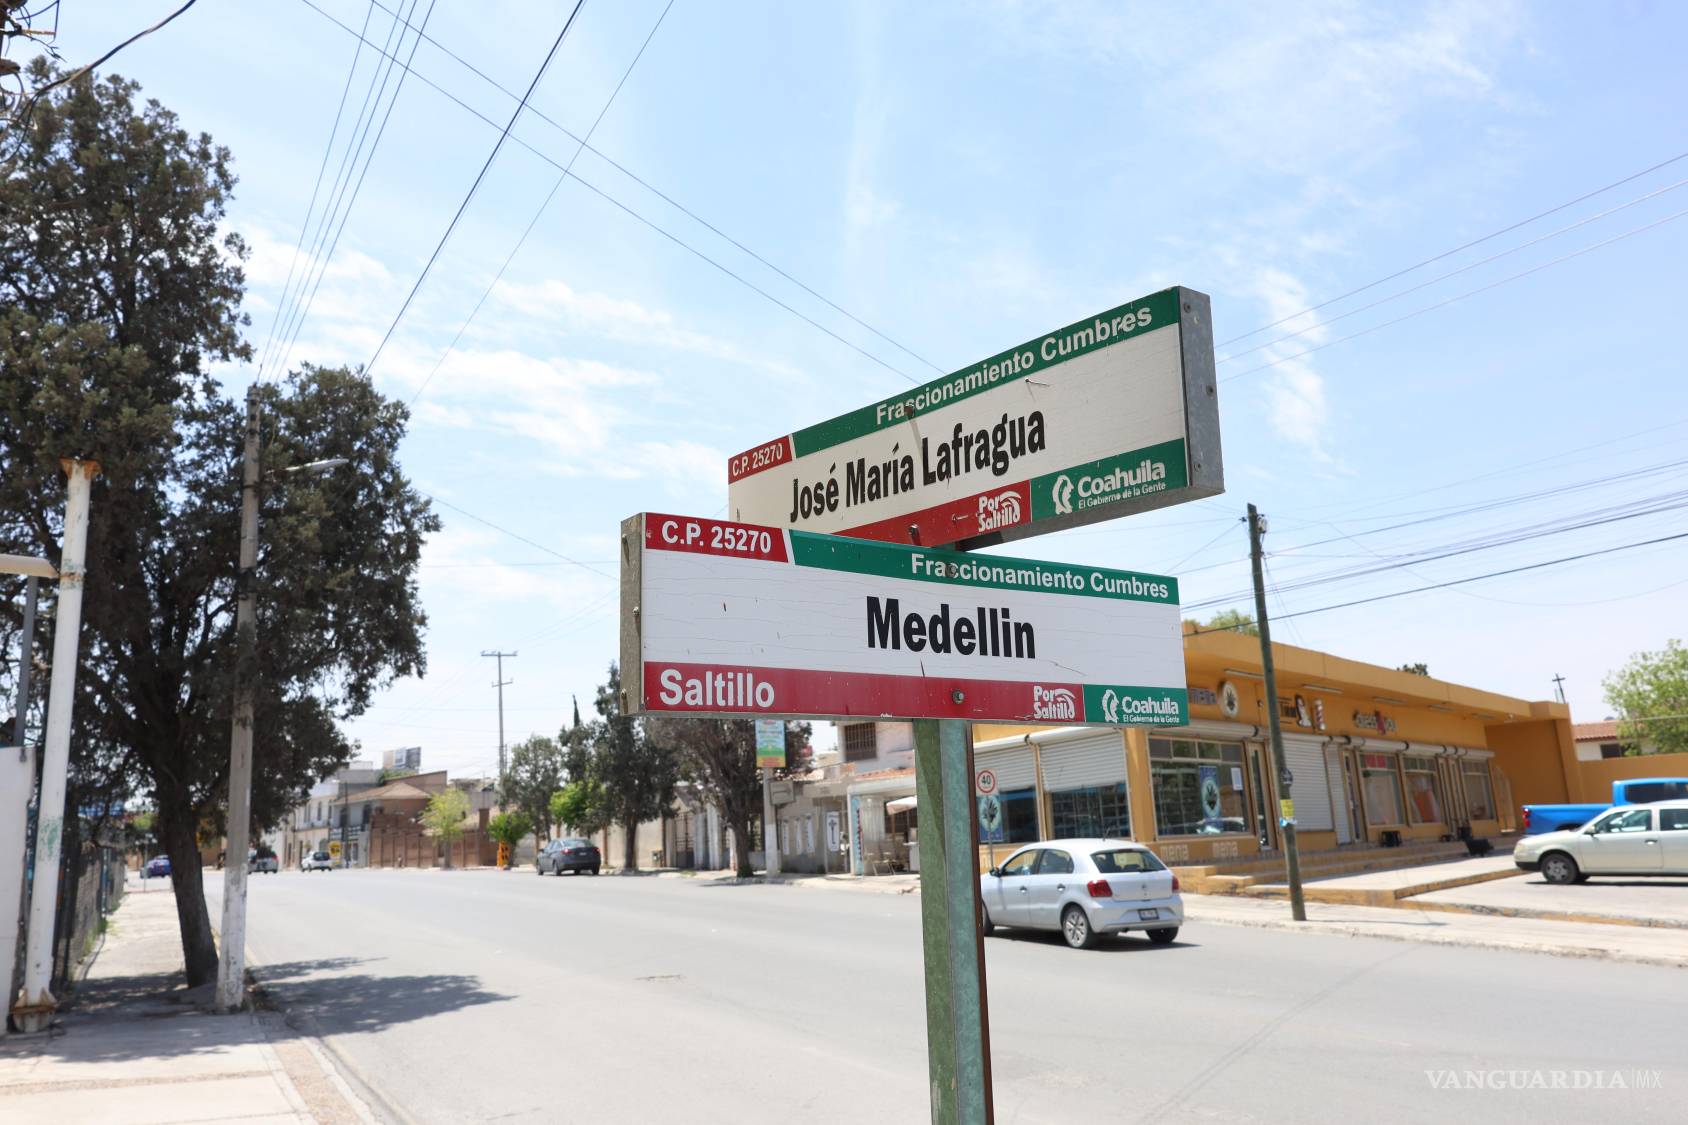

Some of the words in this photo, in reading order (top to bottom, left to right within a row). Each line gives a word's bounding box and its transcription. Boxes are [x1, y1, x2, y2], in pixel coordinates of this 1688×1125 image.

[1040, 307, 1153, 361] Cumbres
[732, 456, 750, 477] C.P.
[752, 442, 783, 469] 25270
[790, 462, 840, 523] José
[846, 442, 914, 508] María
[922, 410, 1046, 487] Lafragua
[1077, 459, 1166, 498] Coahuila
[978, 495, 1000, 514] Por
[1078, 500, 1086, 509] El
[1087, 494, 1121, 507] Gobierno
[1122, 489, 1132, 499] de
[1133, 487, 1141, 497] la
[1142, 482, 1166, 495] Gente
[978, 506, 1021, 533] Saltillo
[661, 520, 704, 547] C.P.
[711, 525, 772, 554] 25270
[1090, 572, 1169, 599] Cumbres
[866, 595, 1036, 659] Medellin
[659, 668, 775, 708] Saltillo
[1033, 685, 1055, 702] Por
[1033, 701, 1076, 720] Saltillo
[1121, 696, 1179, 715] Coahuila
[981, 774, 992, 785] 40
